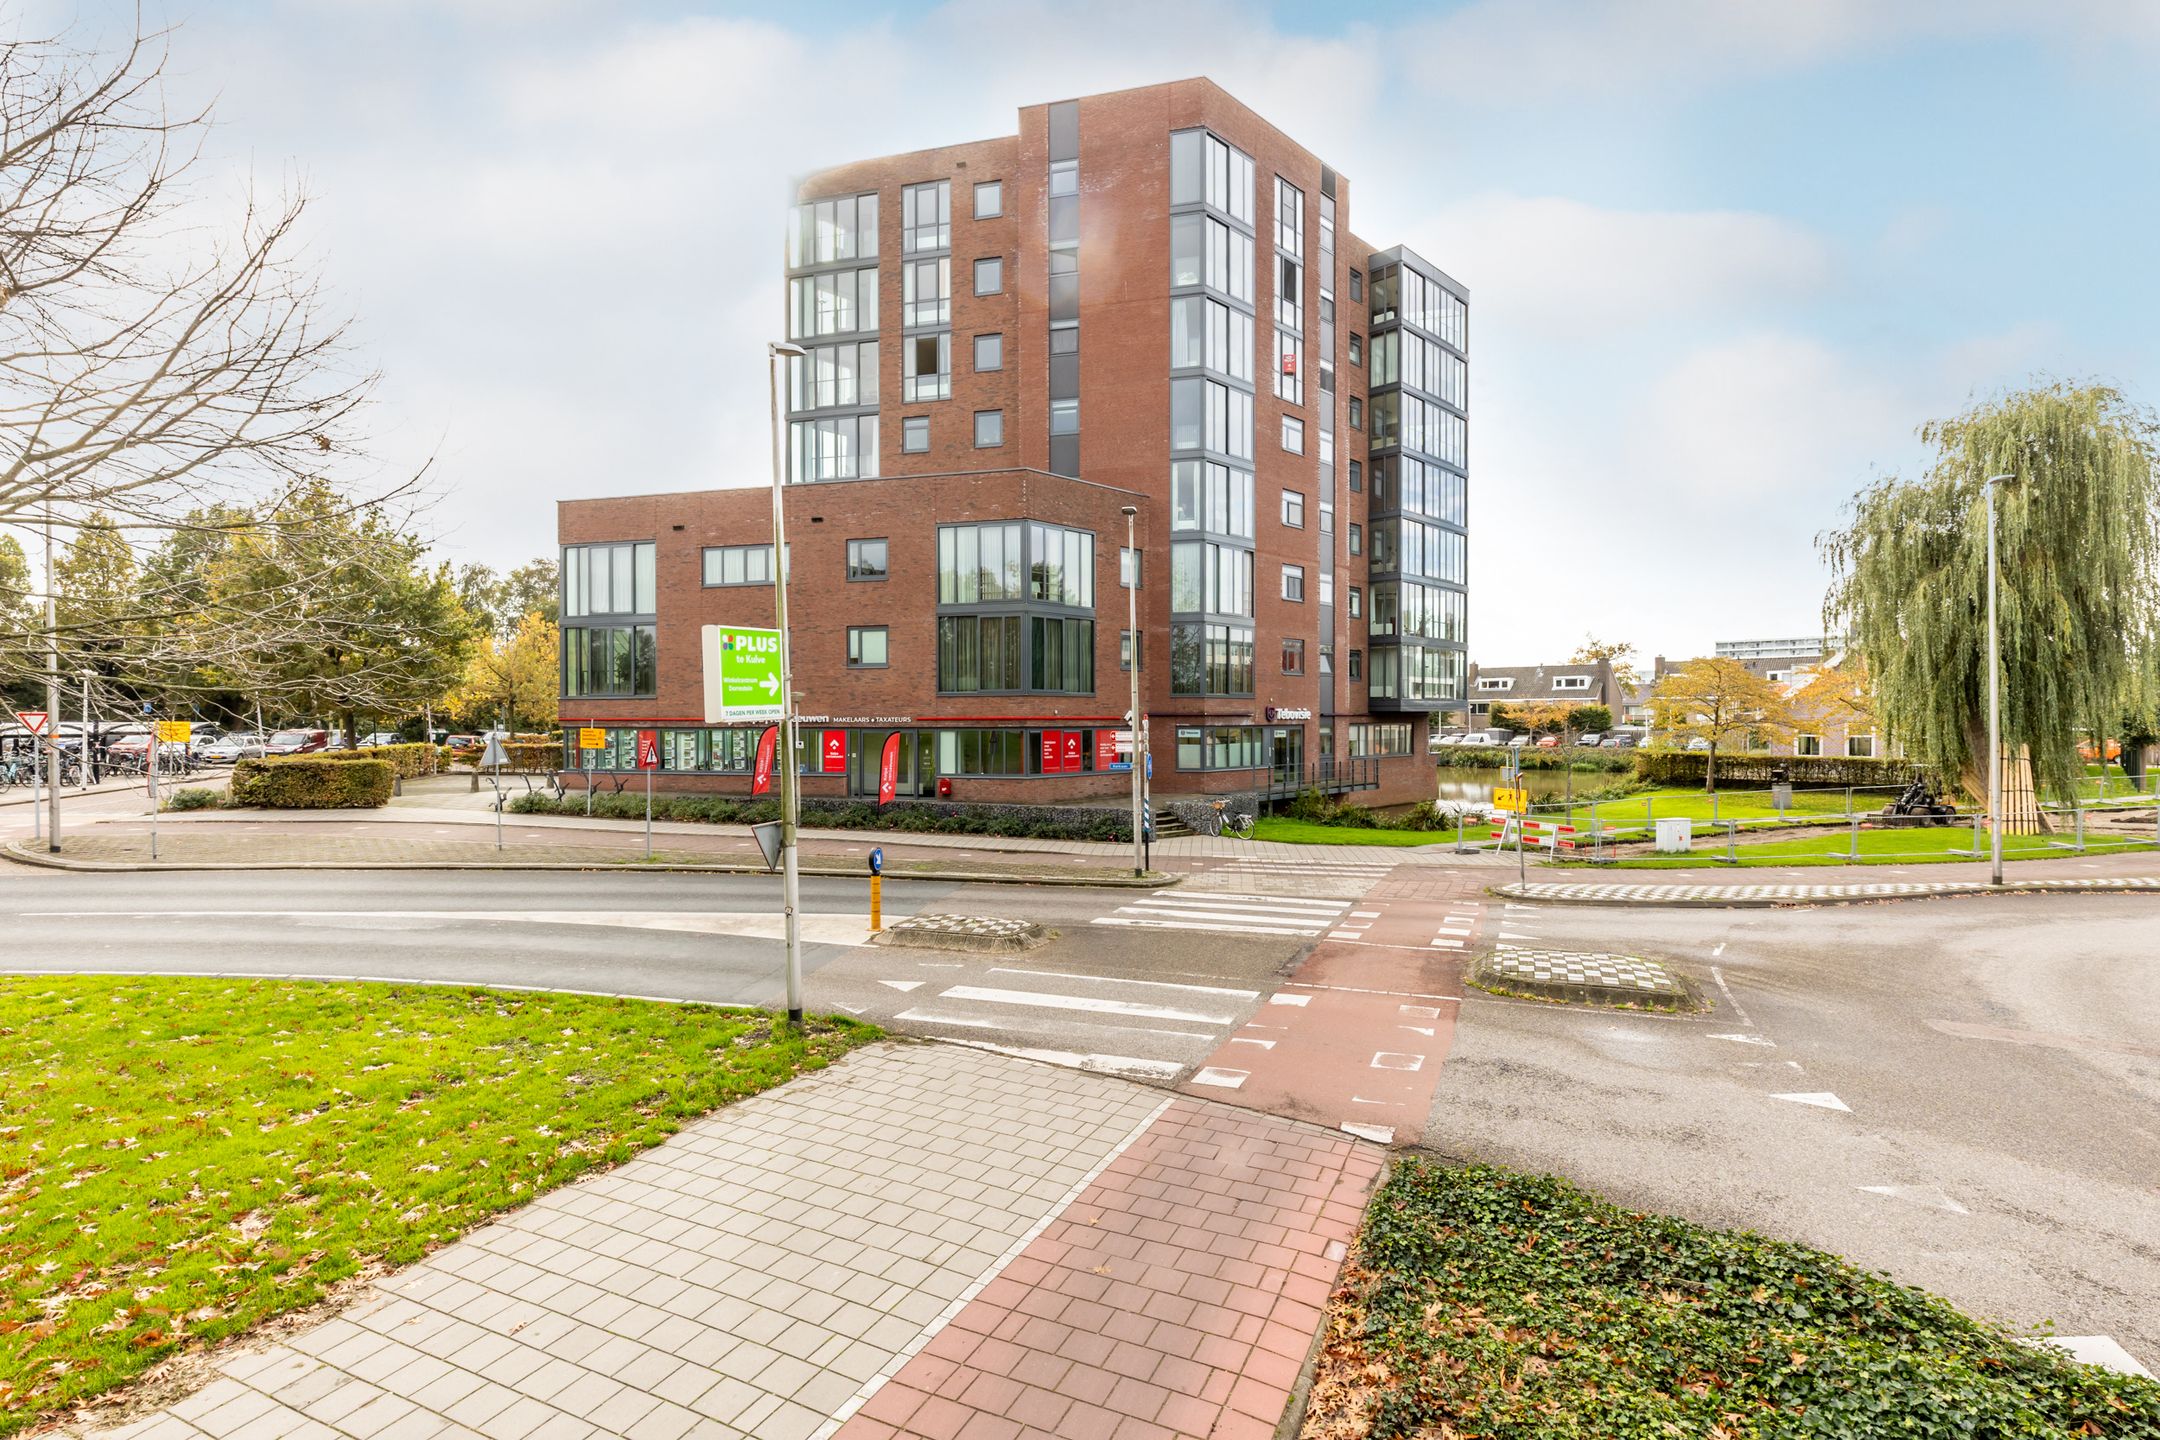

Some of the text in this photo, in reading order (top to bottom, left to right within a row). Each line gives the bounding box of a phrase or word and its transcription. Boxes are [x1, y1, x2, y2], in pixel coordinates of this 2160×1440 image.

[735, 635, 778, 652] PLUS
[729, 709, 746, 717] DAGEN
[1274, 707, 1312, 720] Tebovisie
